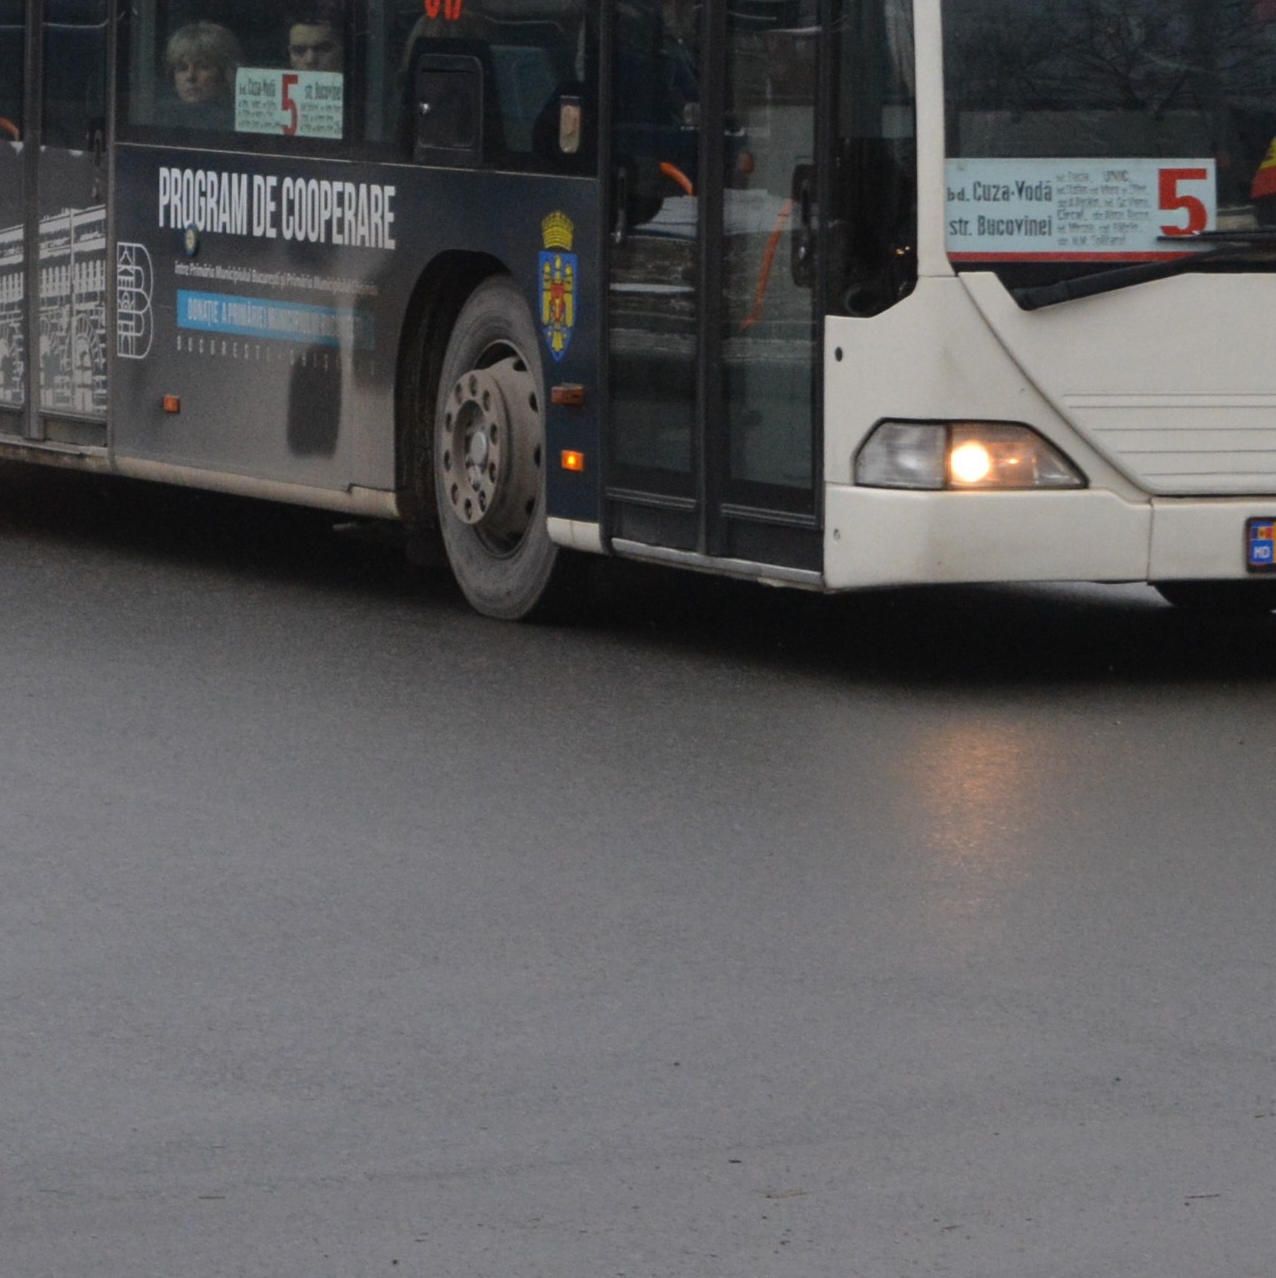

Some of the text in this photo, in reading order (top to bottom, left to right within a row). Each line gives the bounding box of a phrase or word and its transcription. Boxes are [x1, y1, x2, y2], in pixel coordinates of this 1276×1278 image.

[281, 74, 298, 135] 5
[159, 167, 396, 250] PROGRAM DE COOPERARE
[946, 187, 970, 202] bd.
[972, 180, 1053, 202] Cuza-Vodă
[1158, 168, 1207, 237] 5
[949, 218, 972, 237] str.
[977, 215, 1052, 237] Bucovinei
[1253, 545, 1272, 559] MD
